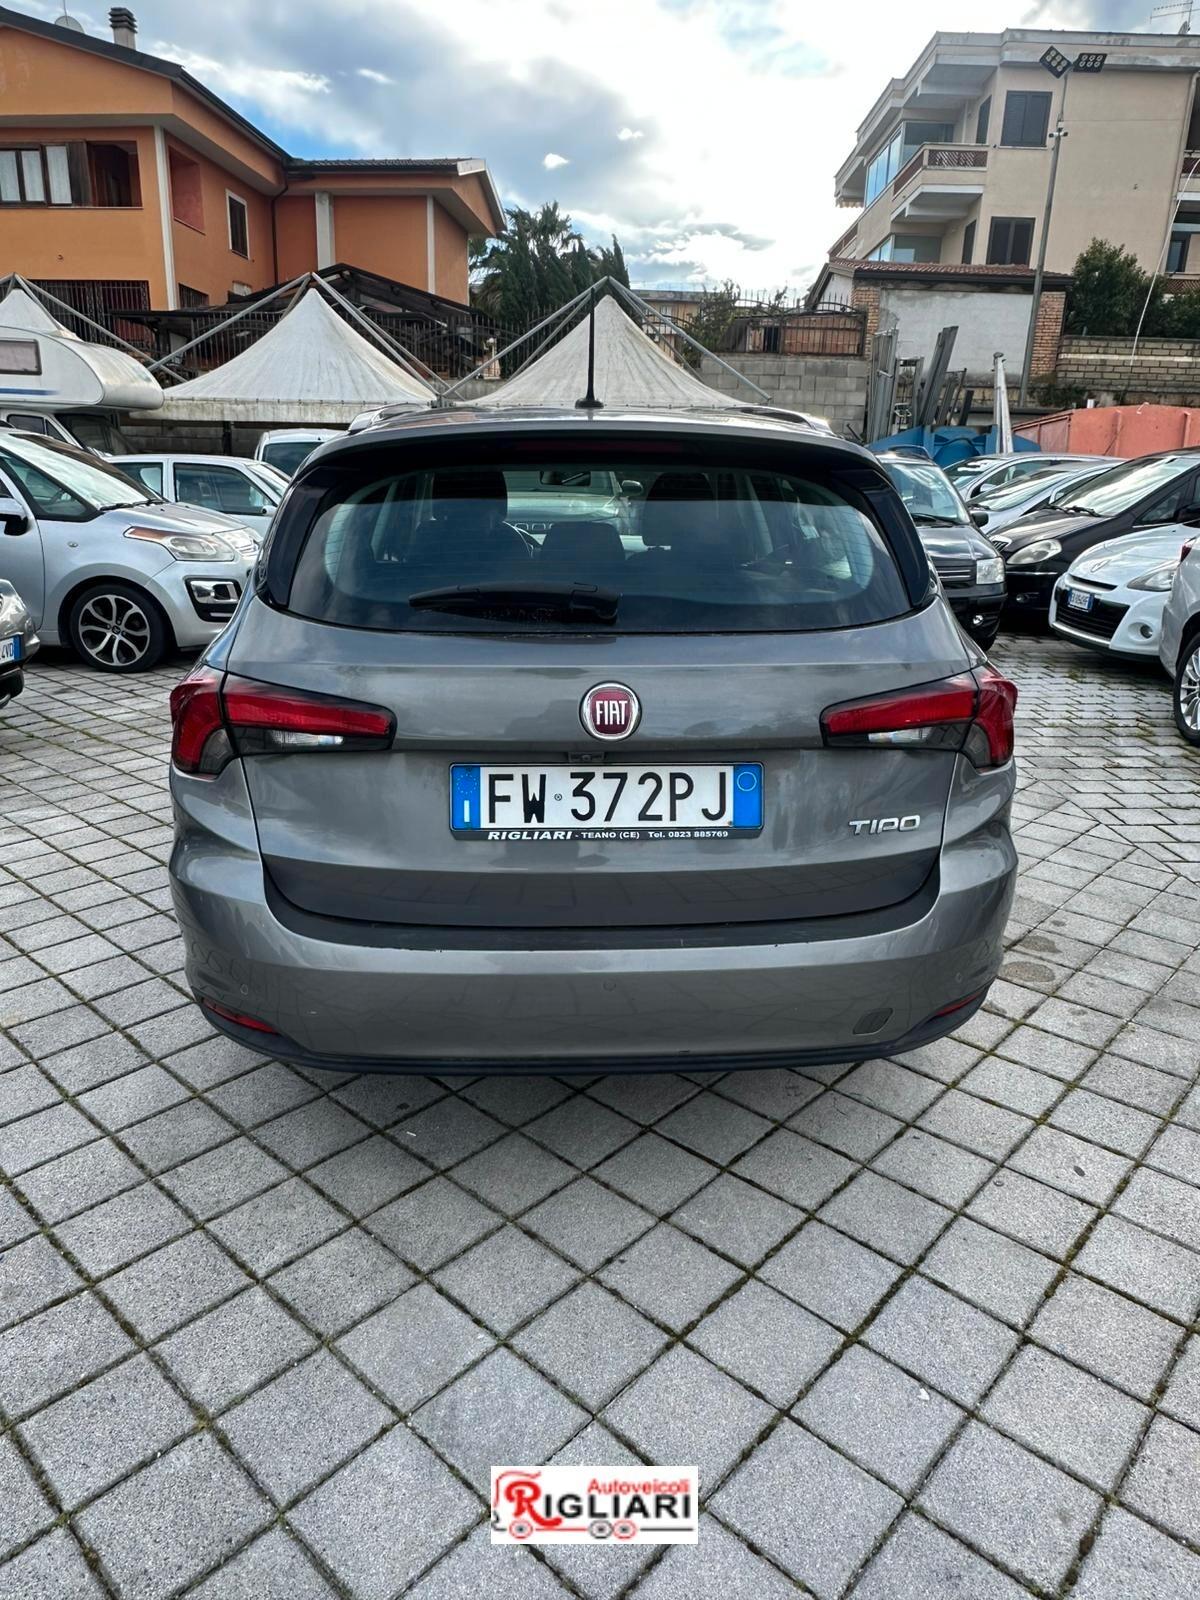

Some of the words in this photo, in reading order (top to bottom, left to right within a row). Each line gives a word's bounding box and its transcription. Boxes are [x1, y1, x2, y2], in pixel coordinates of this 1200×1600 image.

[595, 700, 628, 725] FIAT
[488, 773, 546, 824] FW
[569, 771, 727, 822] 372PJ
[487, 831, 573, 840] RIGLIARI
[581, 831, 617, 839] TEANO
[619, 831, 640, 840] (CE)
[848, 814, 921, 835] TIPO
